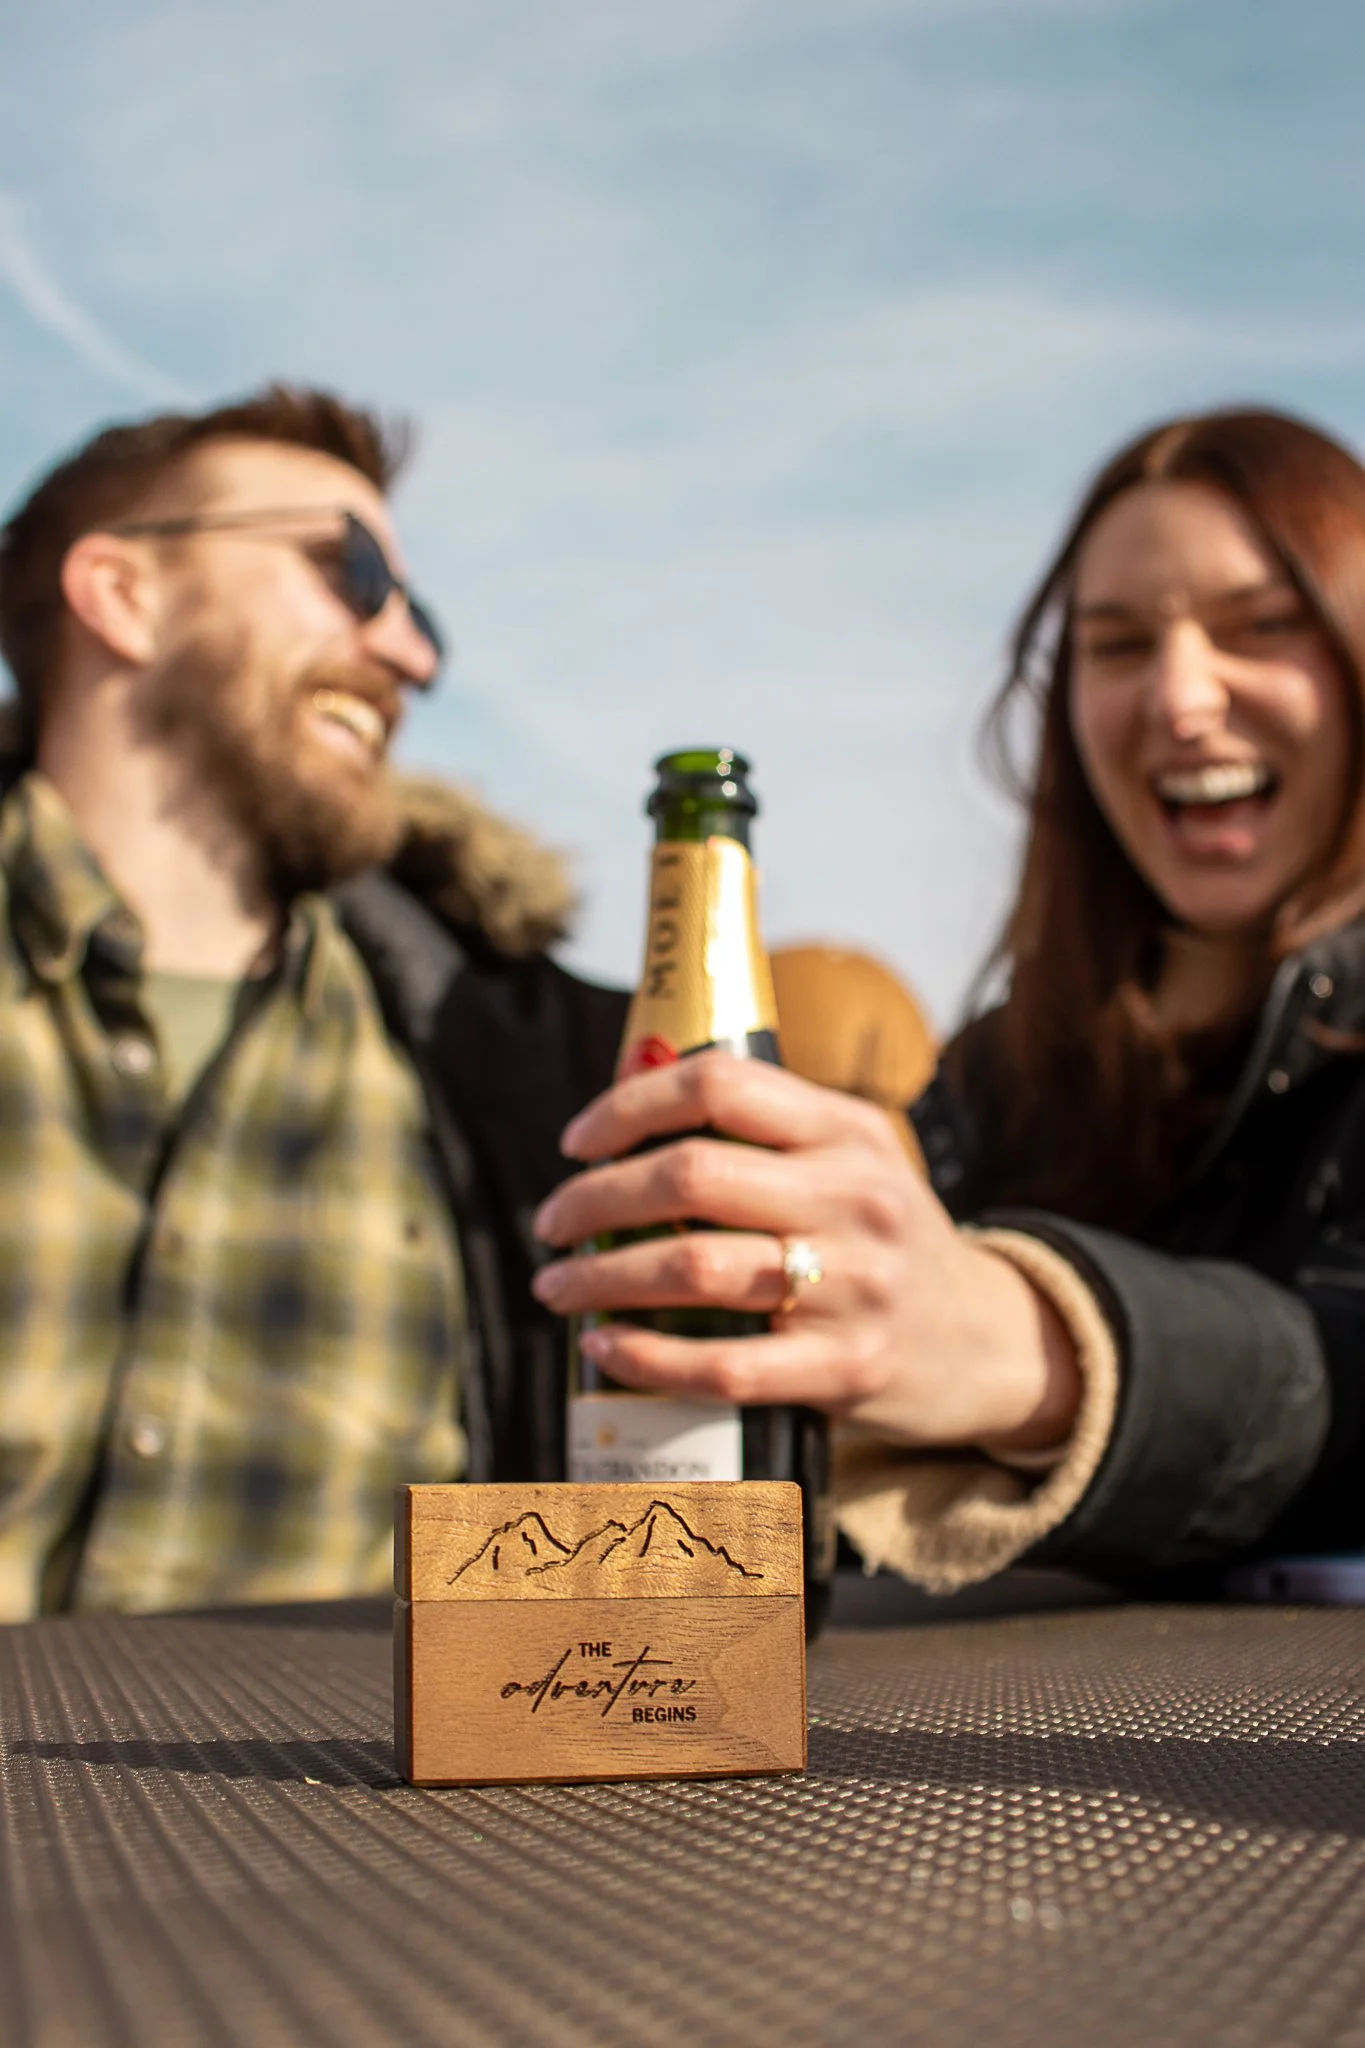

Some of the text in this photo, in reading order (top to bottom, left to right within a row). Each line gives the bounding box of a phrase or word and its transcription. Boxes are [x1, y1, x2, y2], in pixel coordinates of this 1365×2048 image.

[578, 1641, 613, 1658] THE
[500, 1646, 697, 1717] adventure
[631, 1706, 697, 1723] BEGINS
